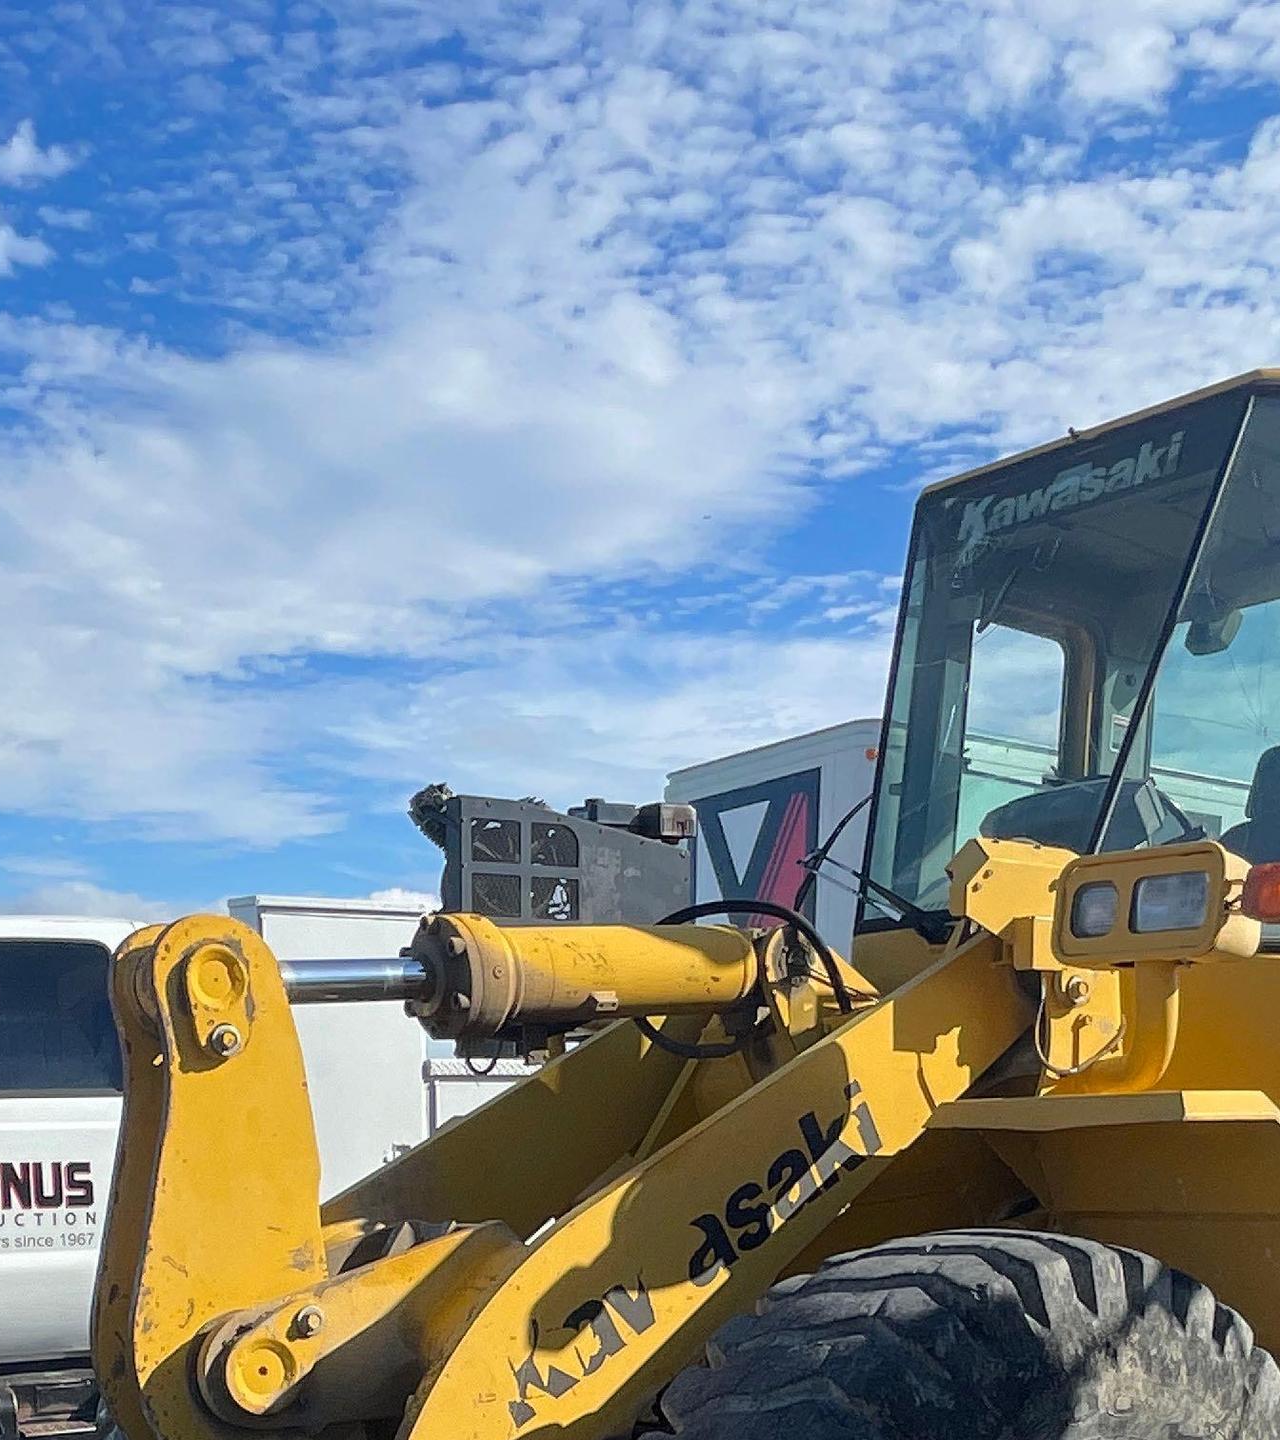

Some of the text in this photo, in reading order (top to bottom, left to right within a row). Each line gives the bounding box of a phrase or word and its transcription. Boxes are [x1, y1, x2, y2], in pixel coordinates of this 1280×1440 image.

[957, 430, 1186, 545] Kawasaki
[14, 1233, 54, 1247] since
[59, 1232, 95, 1247] 1967
